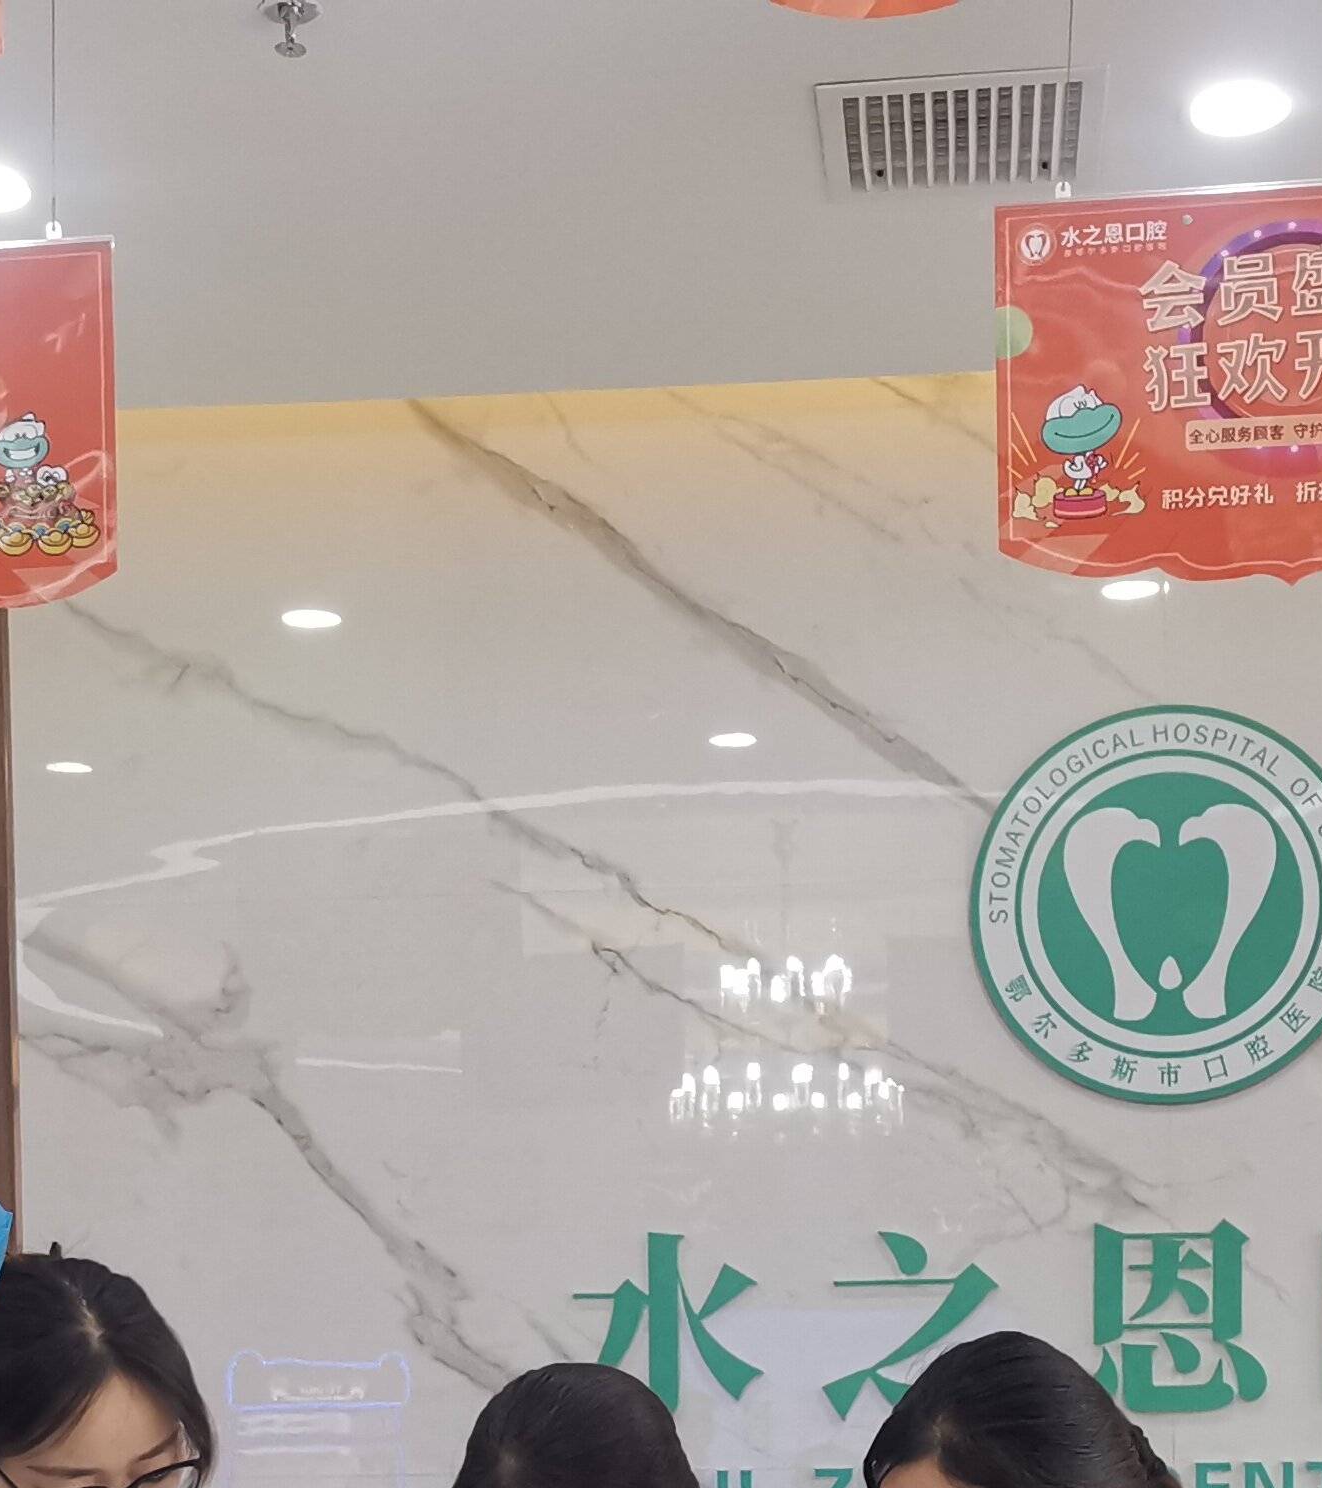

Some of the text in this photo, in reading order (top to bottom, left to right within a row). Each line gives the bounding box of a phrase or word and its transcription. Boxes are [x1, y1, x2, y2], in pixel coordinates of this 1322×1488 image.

[1060, 220, 1167, 248] 水之恩口腔
[1188, 424, 1284, 445] 全心服务顾客
[1162, 486, 1274, 510] 积分兑好礼
[989, 724, 1145, 924] STOMATOLOGICAL
[1152, 722, 1280, 777] HOSPITAL
[1289, 777, 1322, 809] OF
